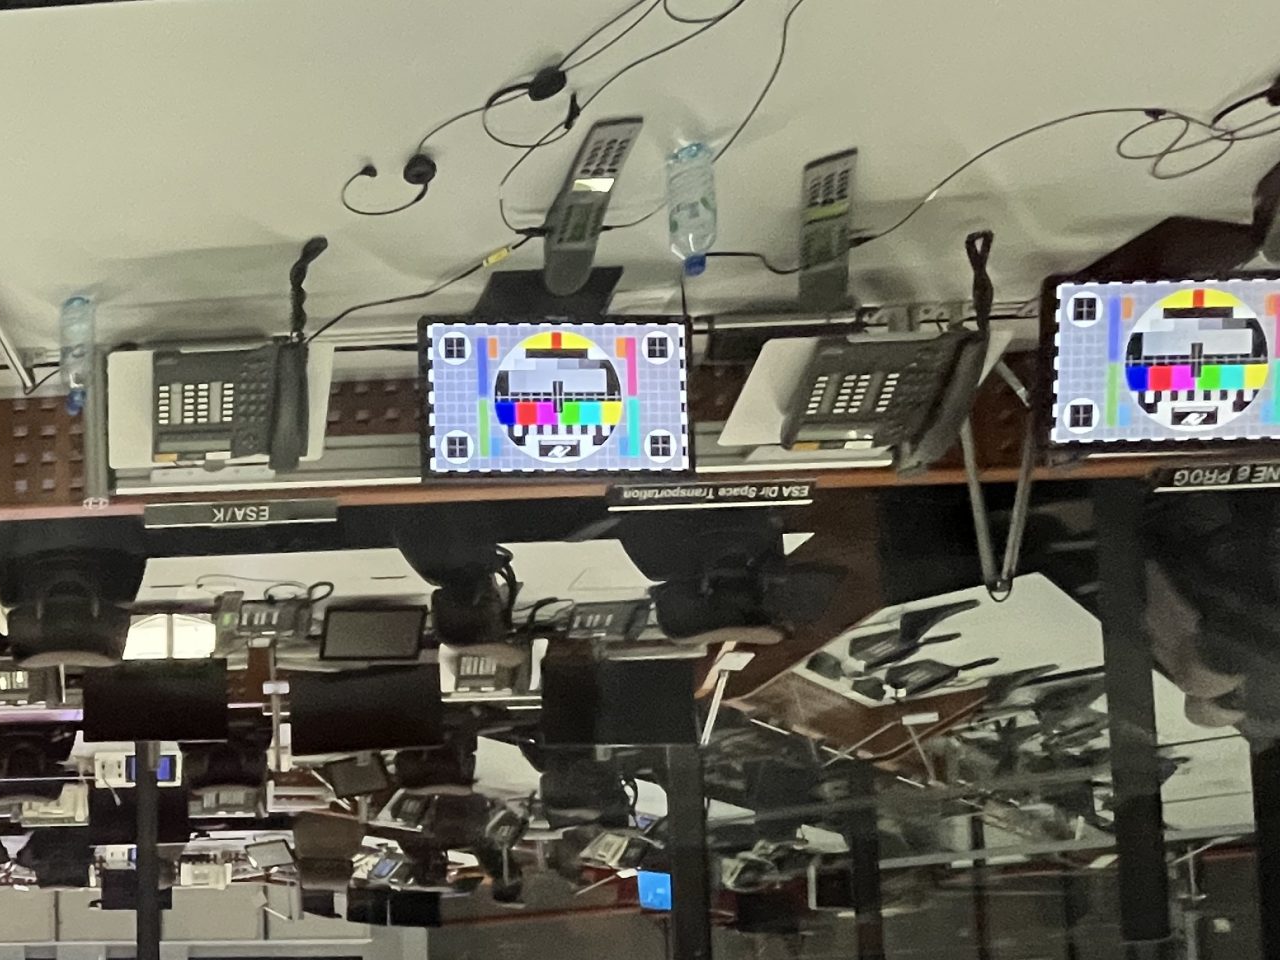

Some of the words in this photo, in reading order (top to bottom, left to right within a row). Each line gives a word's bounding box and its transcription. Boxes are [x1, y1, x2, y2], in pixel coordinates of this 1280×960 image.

[1172, 468, 1233, 487] PROG
[623, 486, 715, 501] Transportation
[718, 486, 757, 499] Space
[759, 485, 779, 498] Dir
[782, 484, 810, 498] ESA
[211, 505, 270, 523] ESA/K
